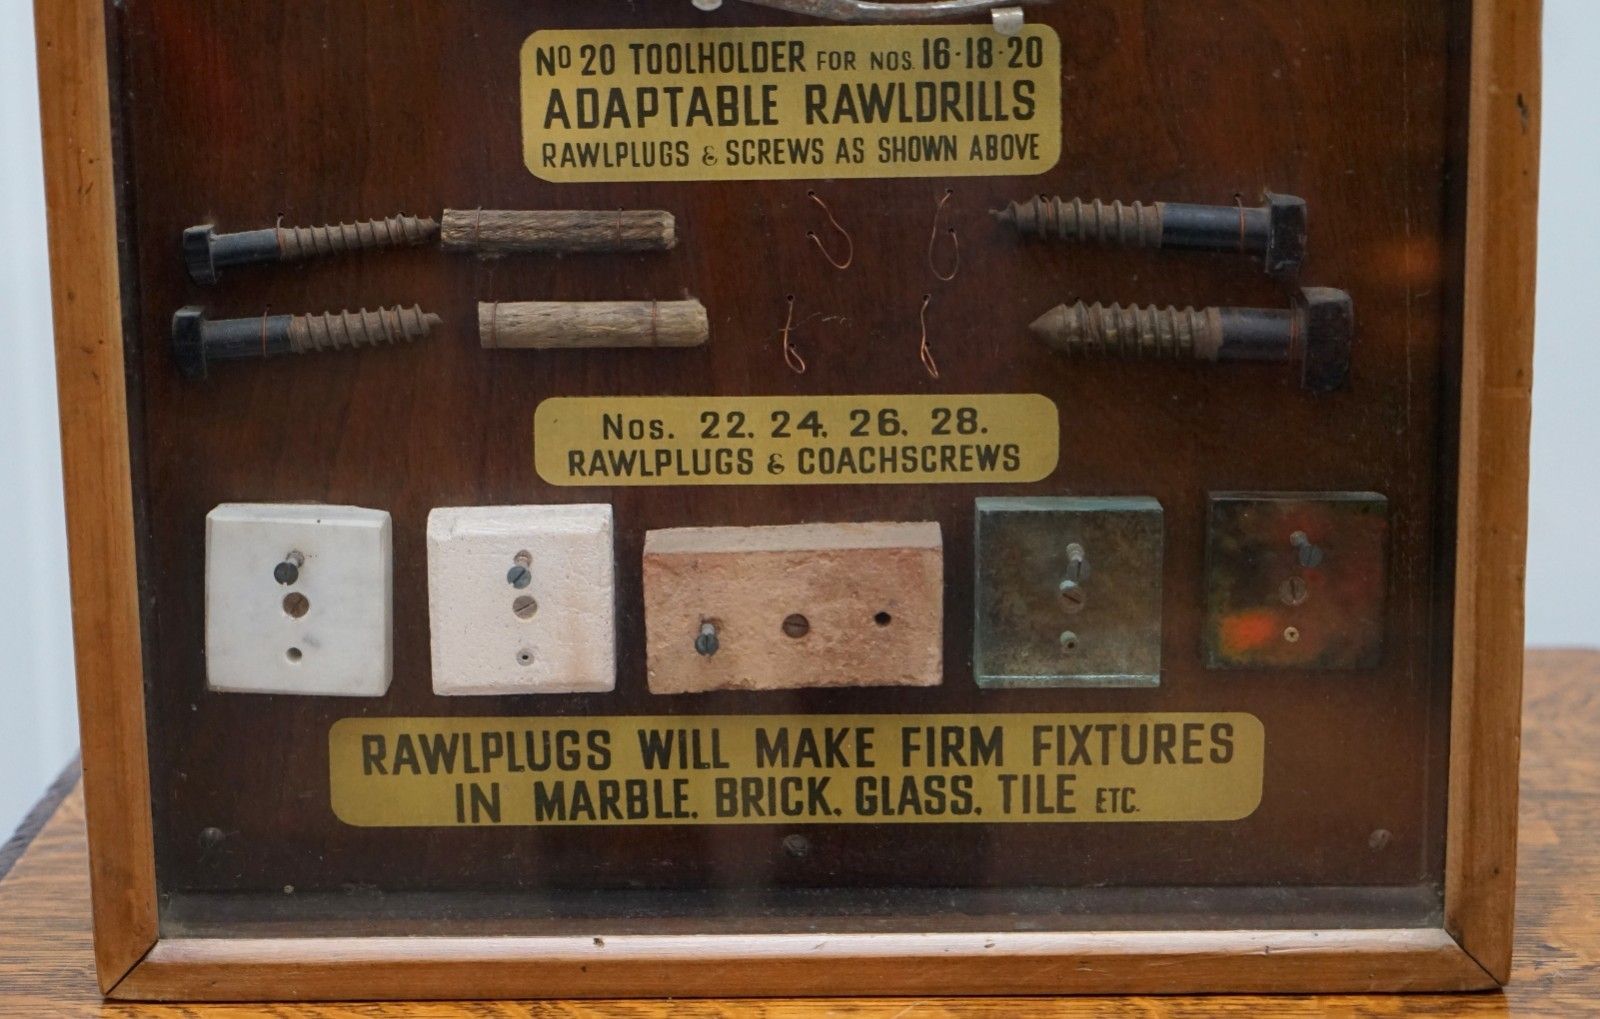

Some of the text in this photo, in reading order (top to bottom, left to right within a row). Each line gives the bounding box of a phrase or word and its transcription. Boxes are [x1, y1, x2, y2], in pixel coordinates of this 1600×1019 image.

[579, 43, 616, 77] 20
[630, 40, 805, 75] TOOLHOLDER
[816, 50, 857, 72] FOR
[543, 79, 1036, 130] ADAPTABLE RAWLDRILLS
[542, 140, 690, 169] RAWLPLUGS
[725, 137, 825, 167] SCREWS
[835, 136, 865, 165] AS
[877, 134, 958, 164] SHOWN
[969, 132, 1041, 162] ABOVE
[567, 447, 754, 477] RAWLPLUGS
[797, 443, 1021, 475] COACHSCREWS
[361, 723, 1233, 775] RAWLPLUGS WILL MAKE FIRM FIXTURES
[456, 782, 502, 824] IN
[998, 773, 1077, 815] TILE
